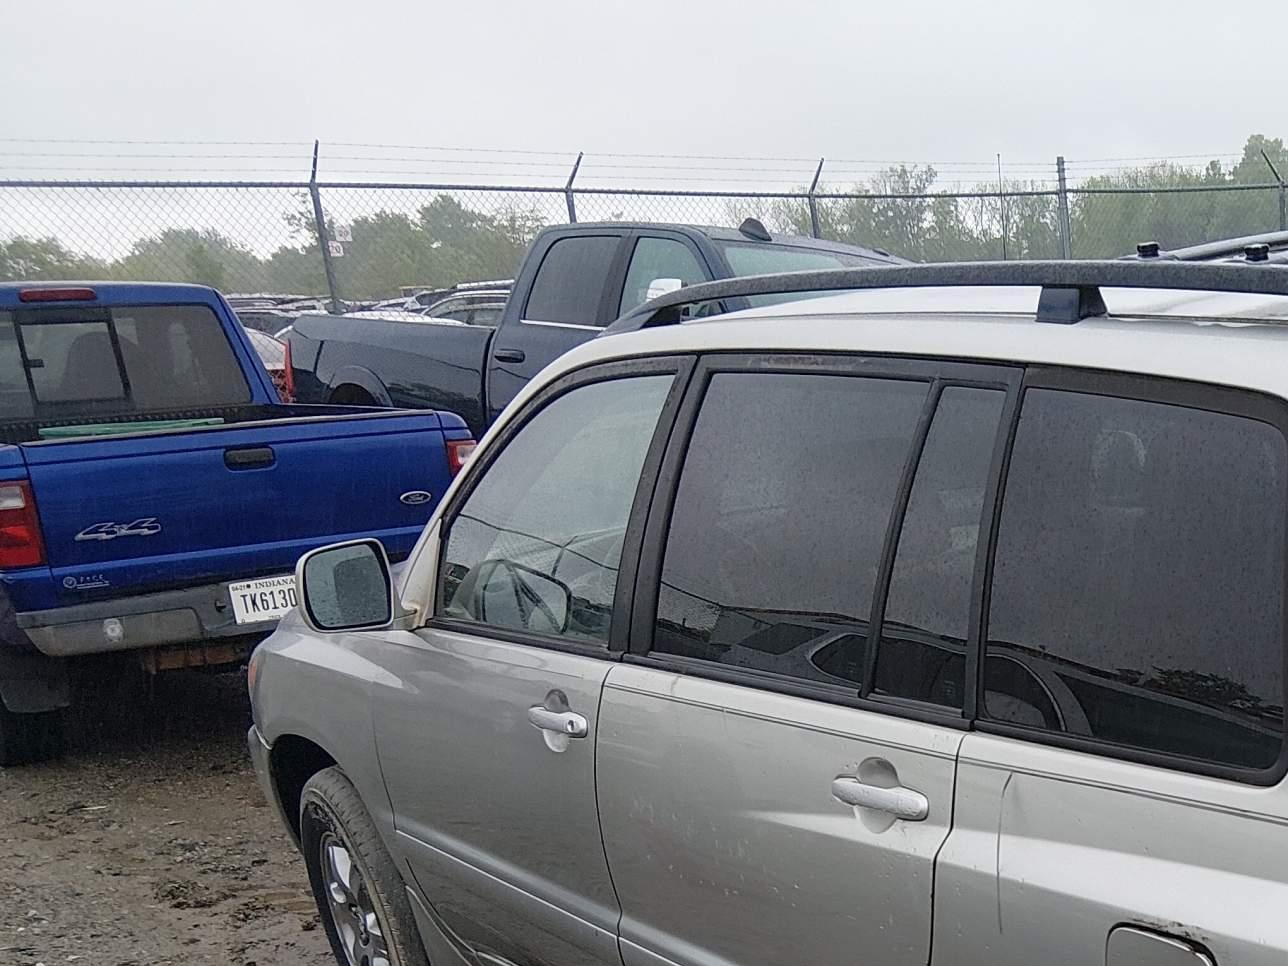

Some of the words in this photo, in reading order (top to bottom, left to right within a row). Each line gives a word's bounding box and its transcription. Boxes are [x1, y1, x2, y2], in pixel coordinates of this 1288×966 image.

[74, 517, 162, 541] 4x4
[254, 577, 296, 590] INDIANA
[240, 587, 298, 614] TK6130
